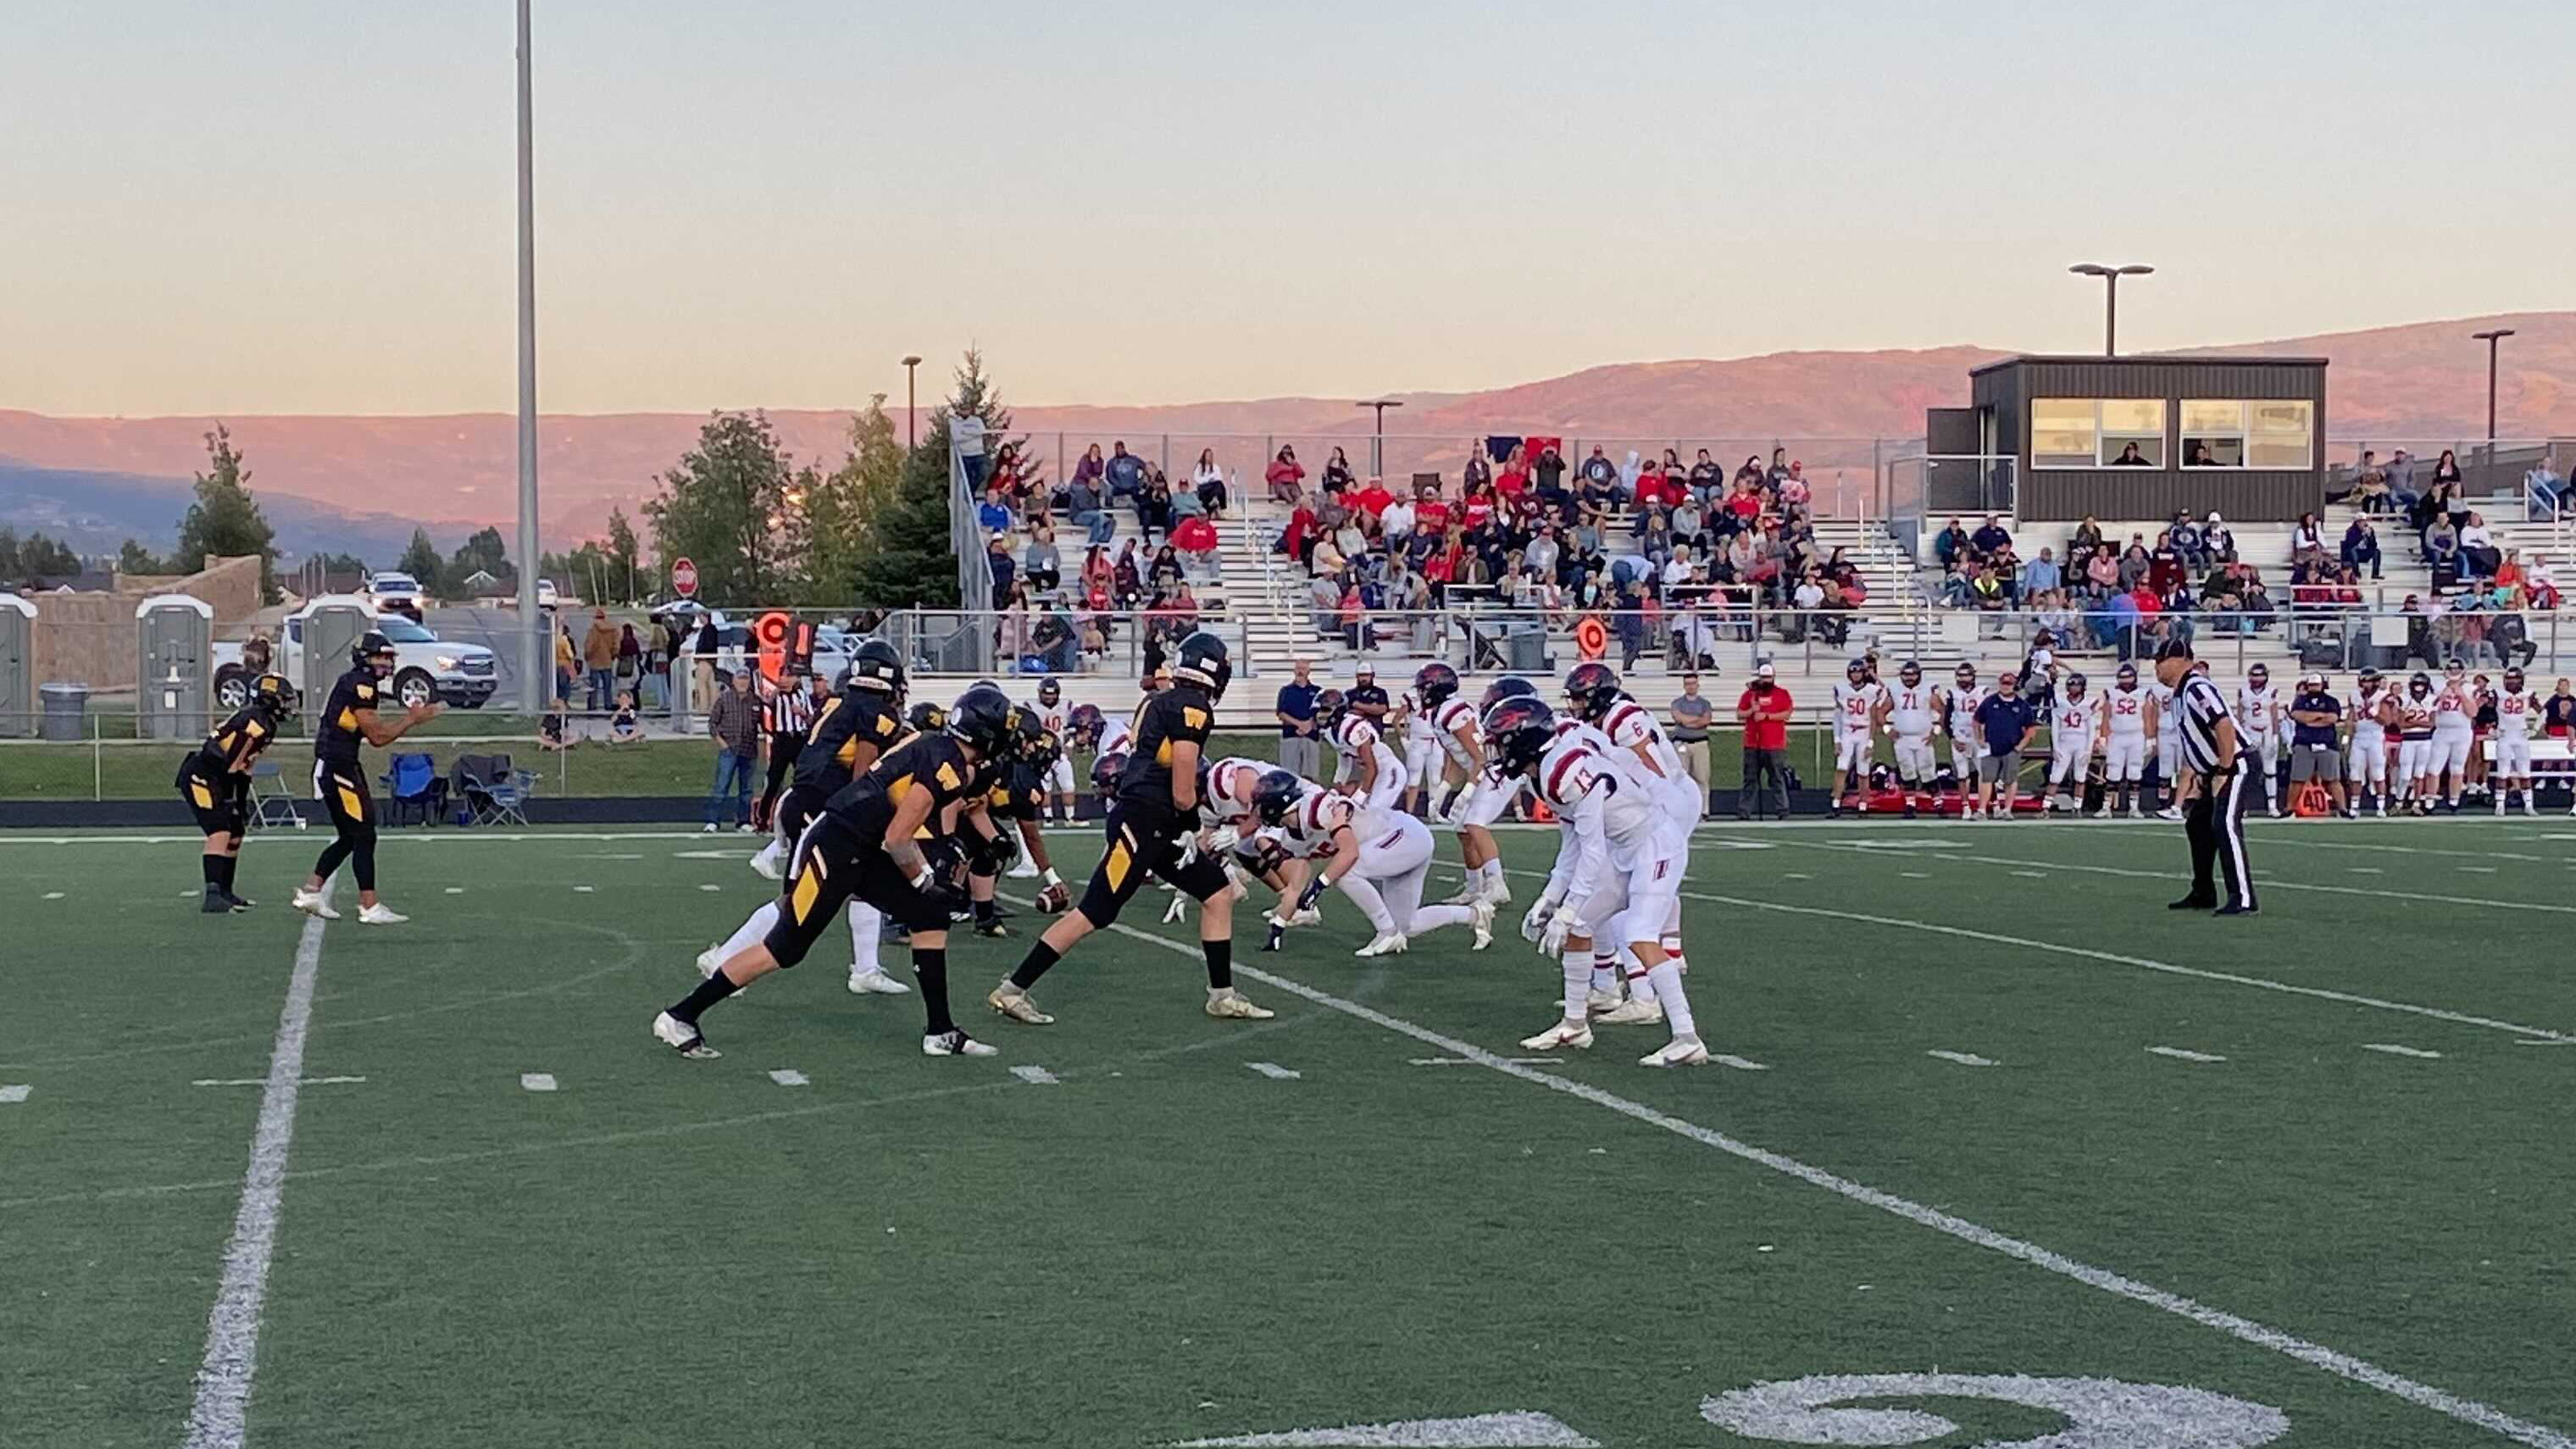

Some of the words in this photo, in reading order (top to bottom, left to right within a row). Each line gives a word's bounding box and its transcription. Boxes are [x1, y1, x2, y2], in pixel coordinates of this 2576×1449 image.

[674, 569, 695, 584] STOP
[1846, 698, 1865, 715] 50
[1901, 693, 1918, 710] 71
[1961, 698, 1977, 713] 12
[2116, 698, 2136, 714] 52
[2251, 702, 2262, 717] 2
[2504, 697, 2523, 714] 92
[2302, 789, 2327, 813] 40
